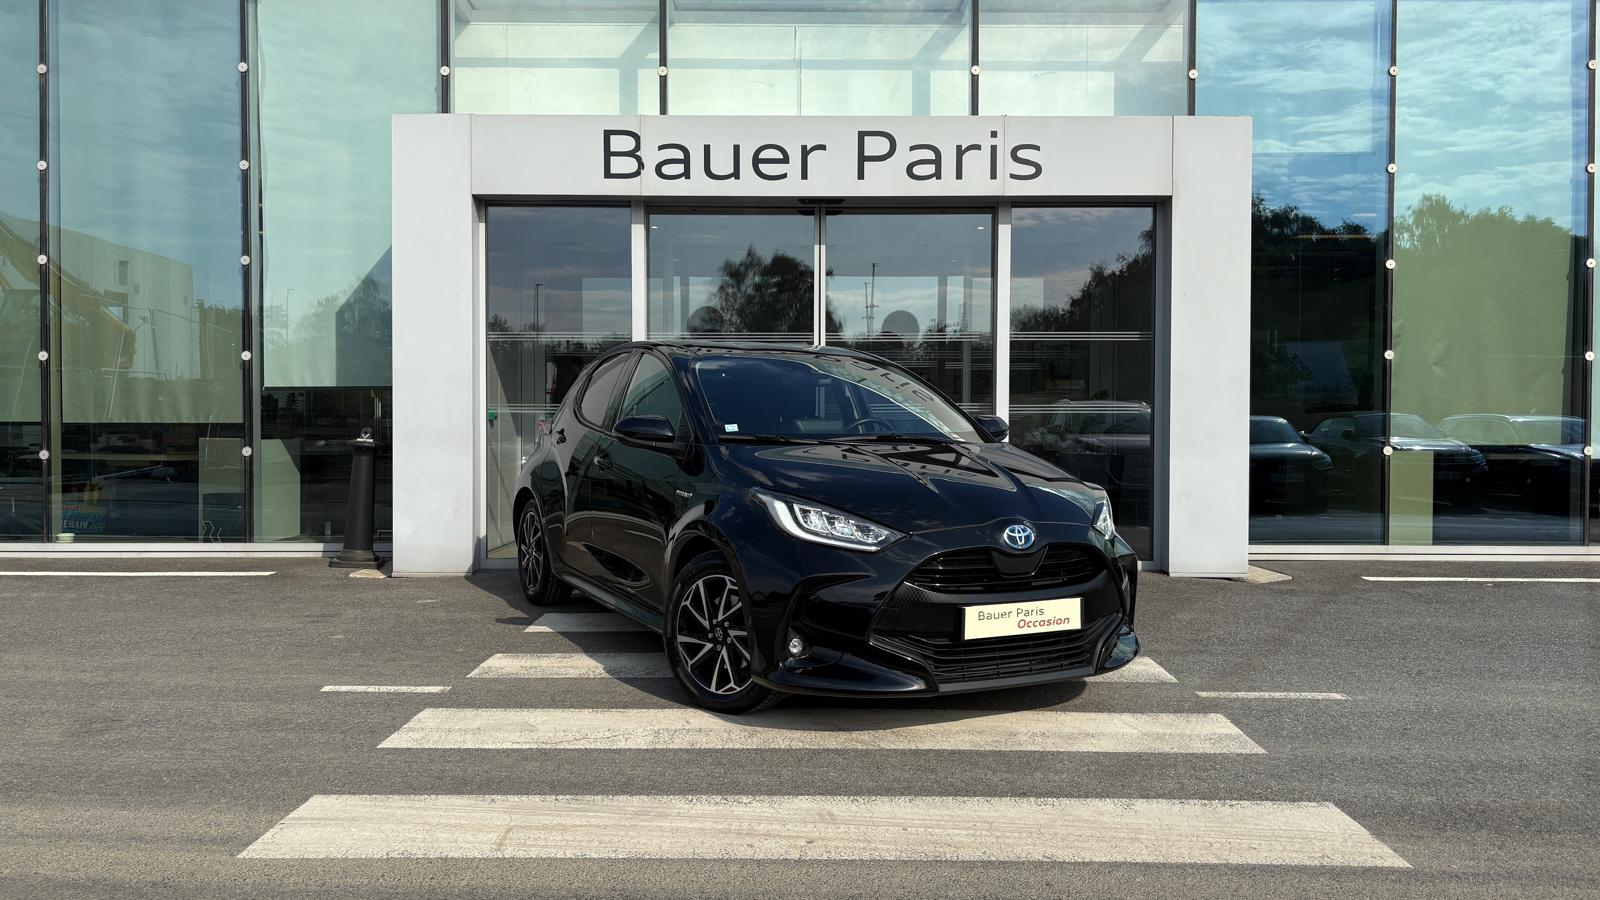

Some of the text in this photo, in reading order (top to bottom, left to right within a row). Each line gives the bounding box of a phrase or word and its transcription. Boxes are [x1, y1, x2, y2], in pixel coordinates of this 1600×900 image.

[603, 129, 1043, 181] Bauer Paris
[978, 607, 1045, 621] Bauer Paris
[1017, 616, 1070, 629] Occasion
